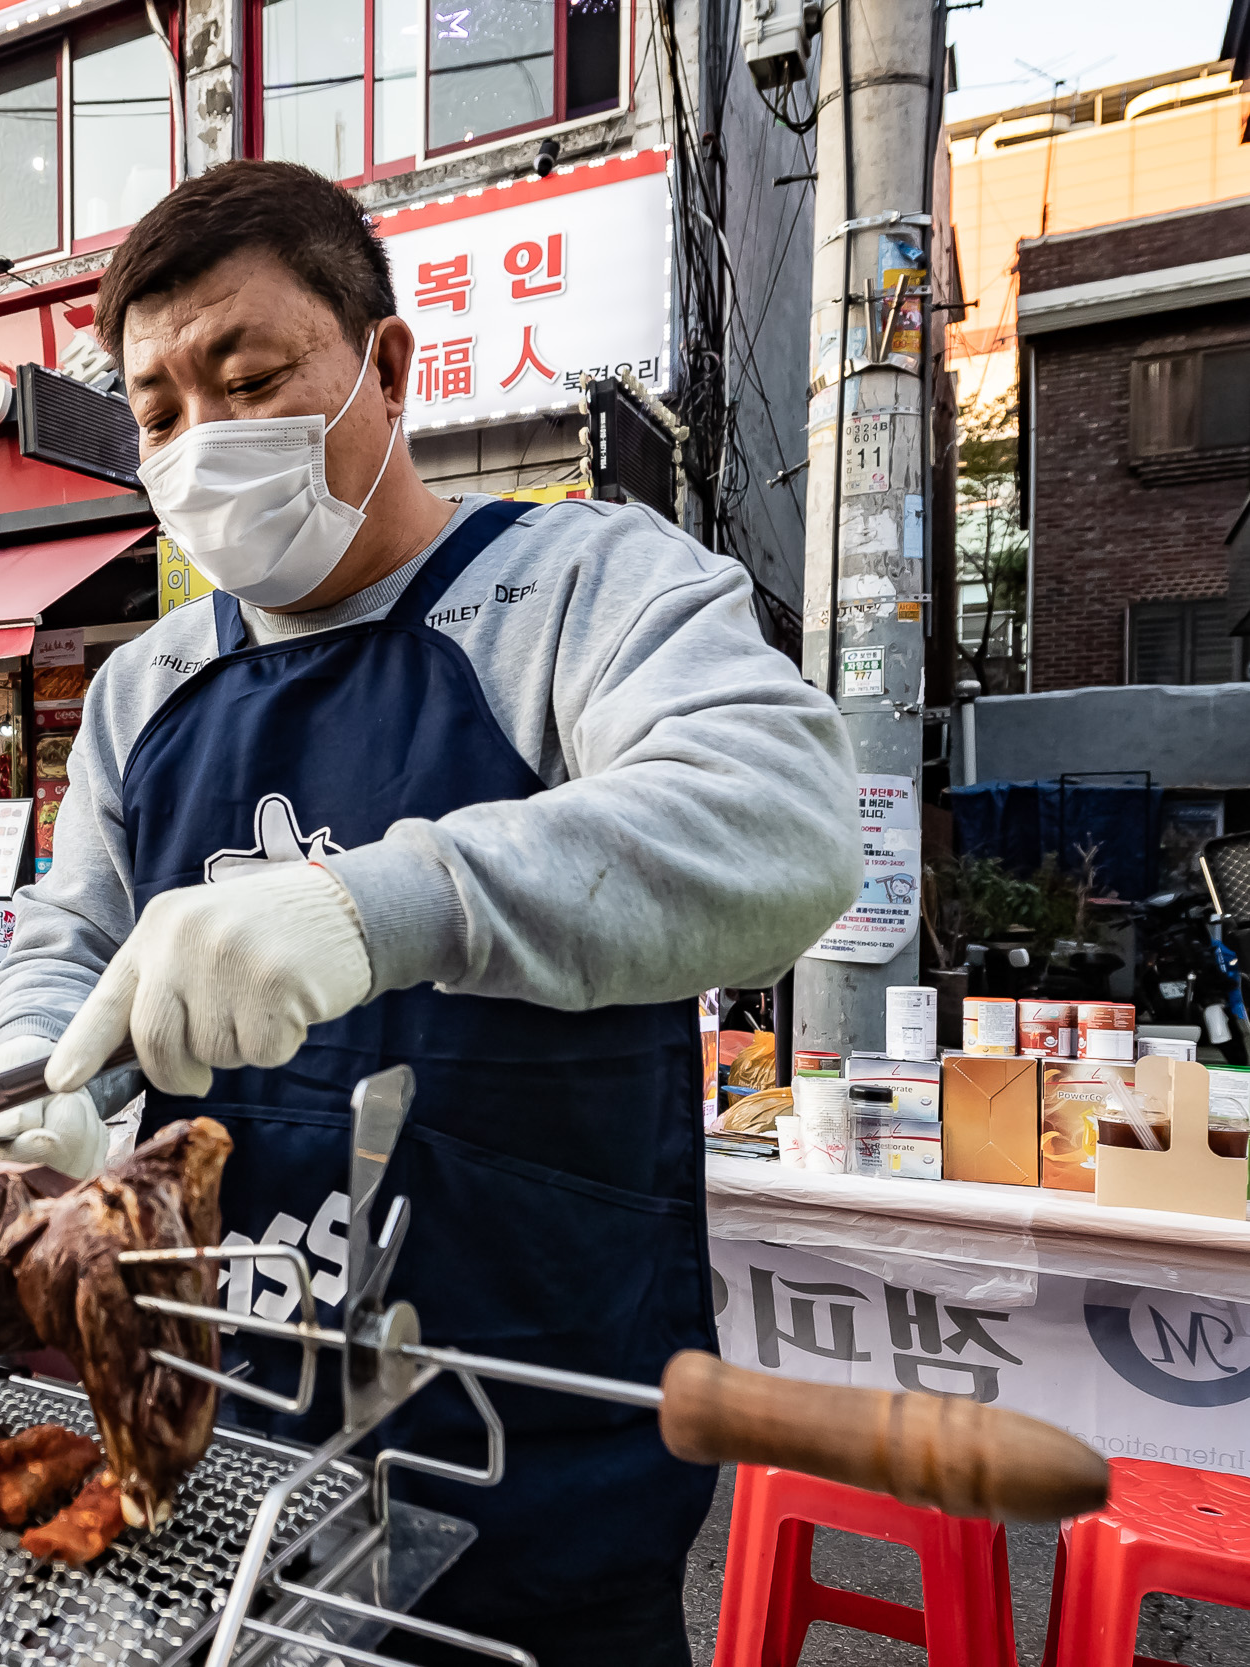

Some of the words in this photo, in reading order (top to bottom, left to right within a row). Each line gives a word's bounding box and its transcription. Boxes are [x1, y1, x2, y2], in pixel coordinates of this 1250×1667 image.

[414, 233, 562, 312] 복인
[416, 325, 557, 402] 福人
[854, 432, 878, 444] 601
[494, 580, 538, 604] DEPT.
[854, 671, 872, 681] 777
[869, 798, 895, 809] 버리는
